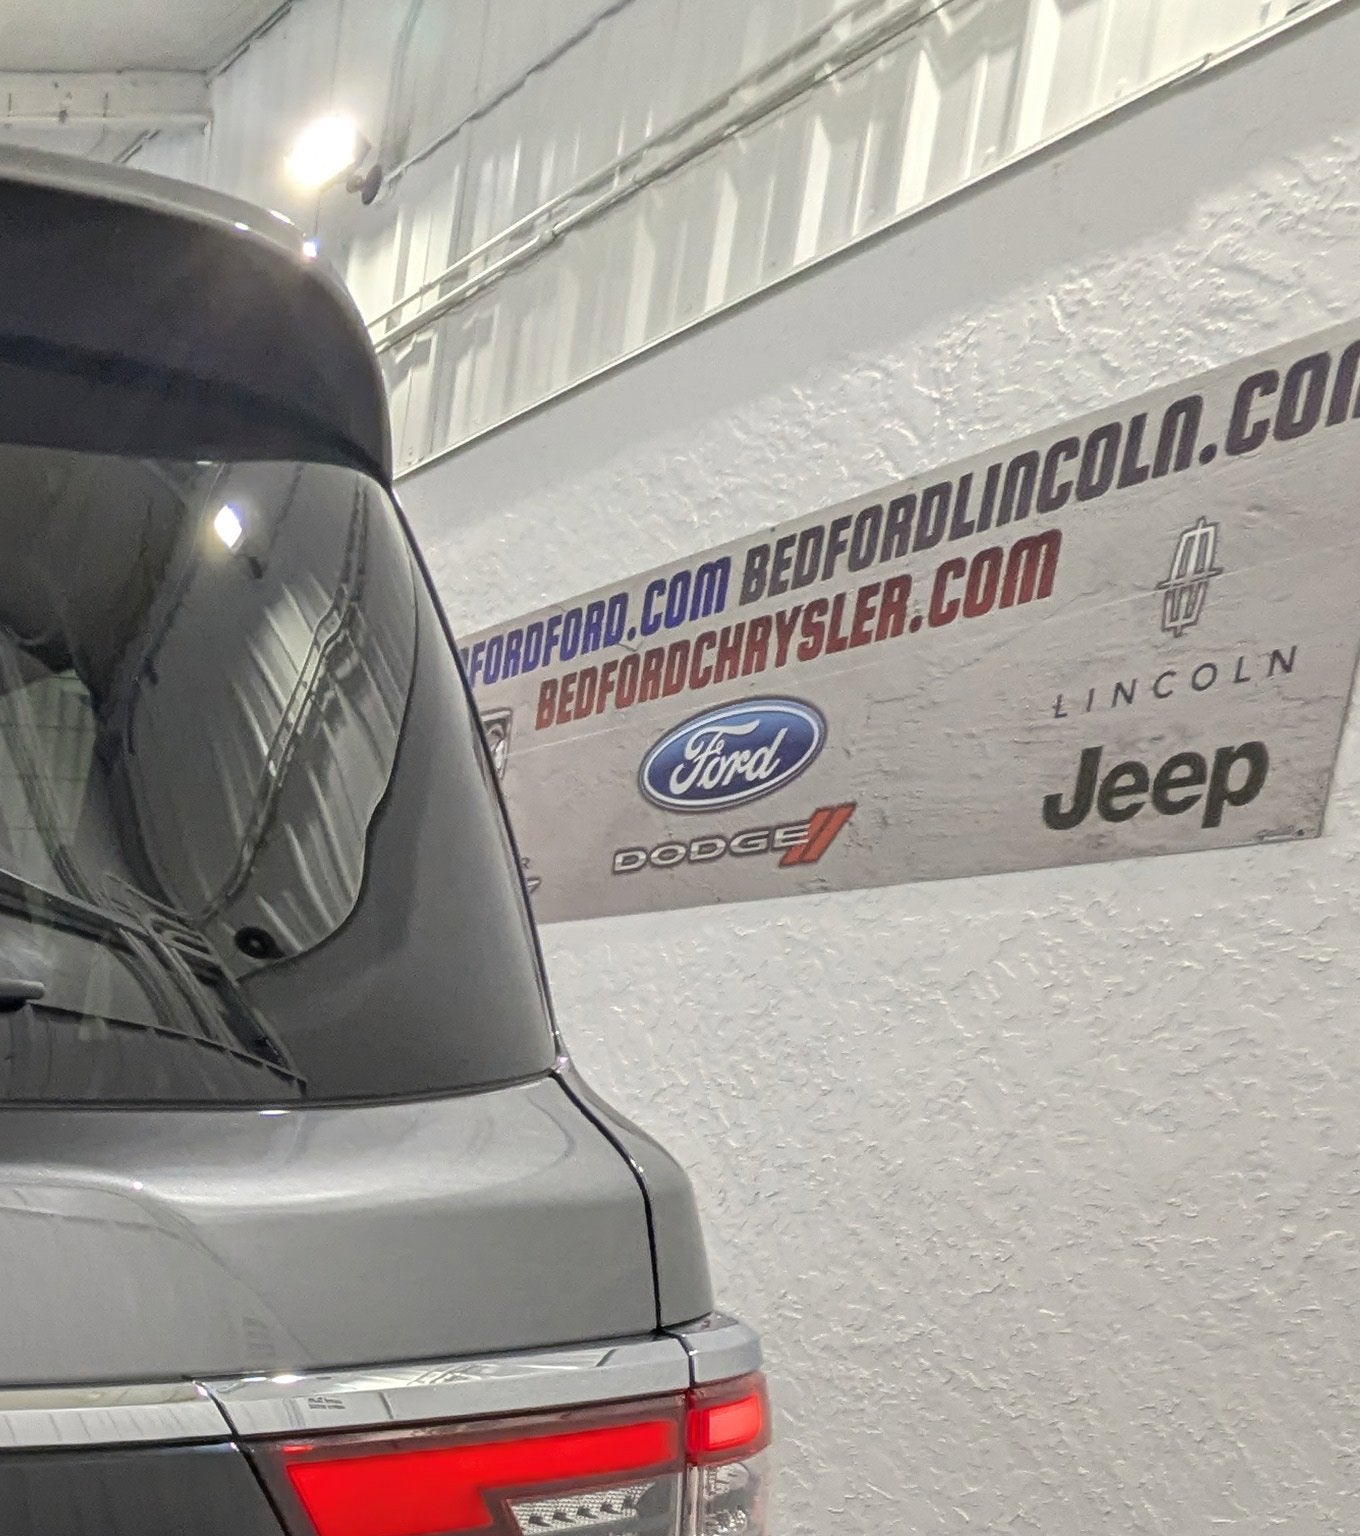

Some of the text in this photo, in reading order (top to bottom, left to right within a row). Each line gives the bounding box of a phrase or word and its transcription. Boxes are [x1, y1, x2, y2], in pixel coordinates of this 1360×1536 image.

[535, 529, 1063, 730] BEDFORDCHRYSLER.COM
[1053, 645, 1298, 718] LINCOLN
[669, 719, 788, 795] Ford
[1042, 741, 1269, 830] Jeep
[612, 819, 813, 875] DODGE
